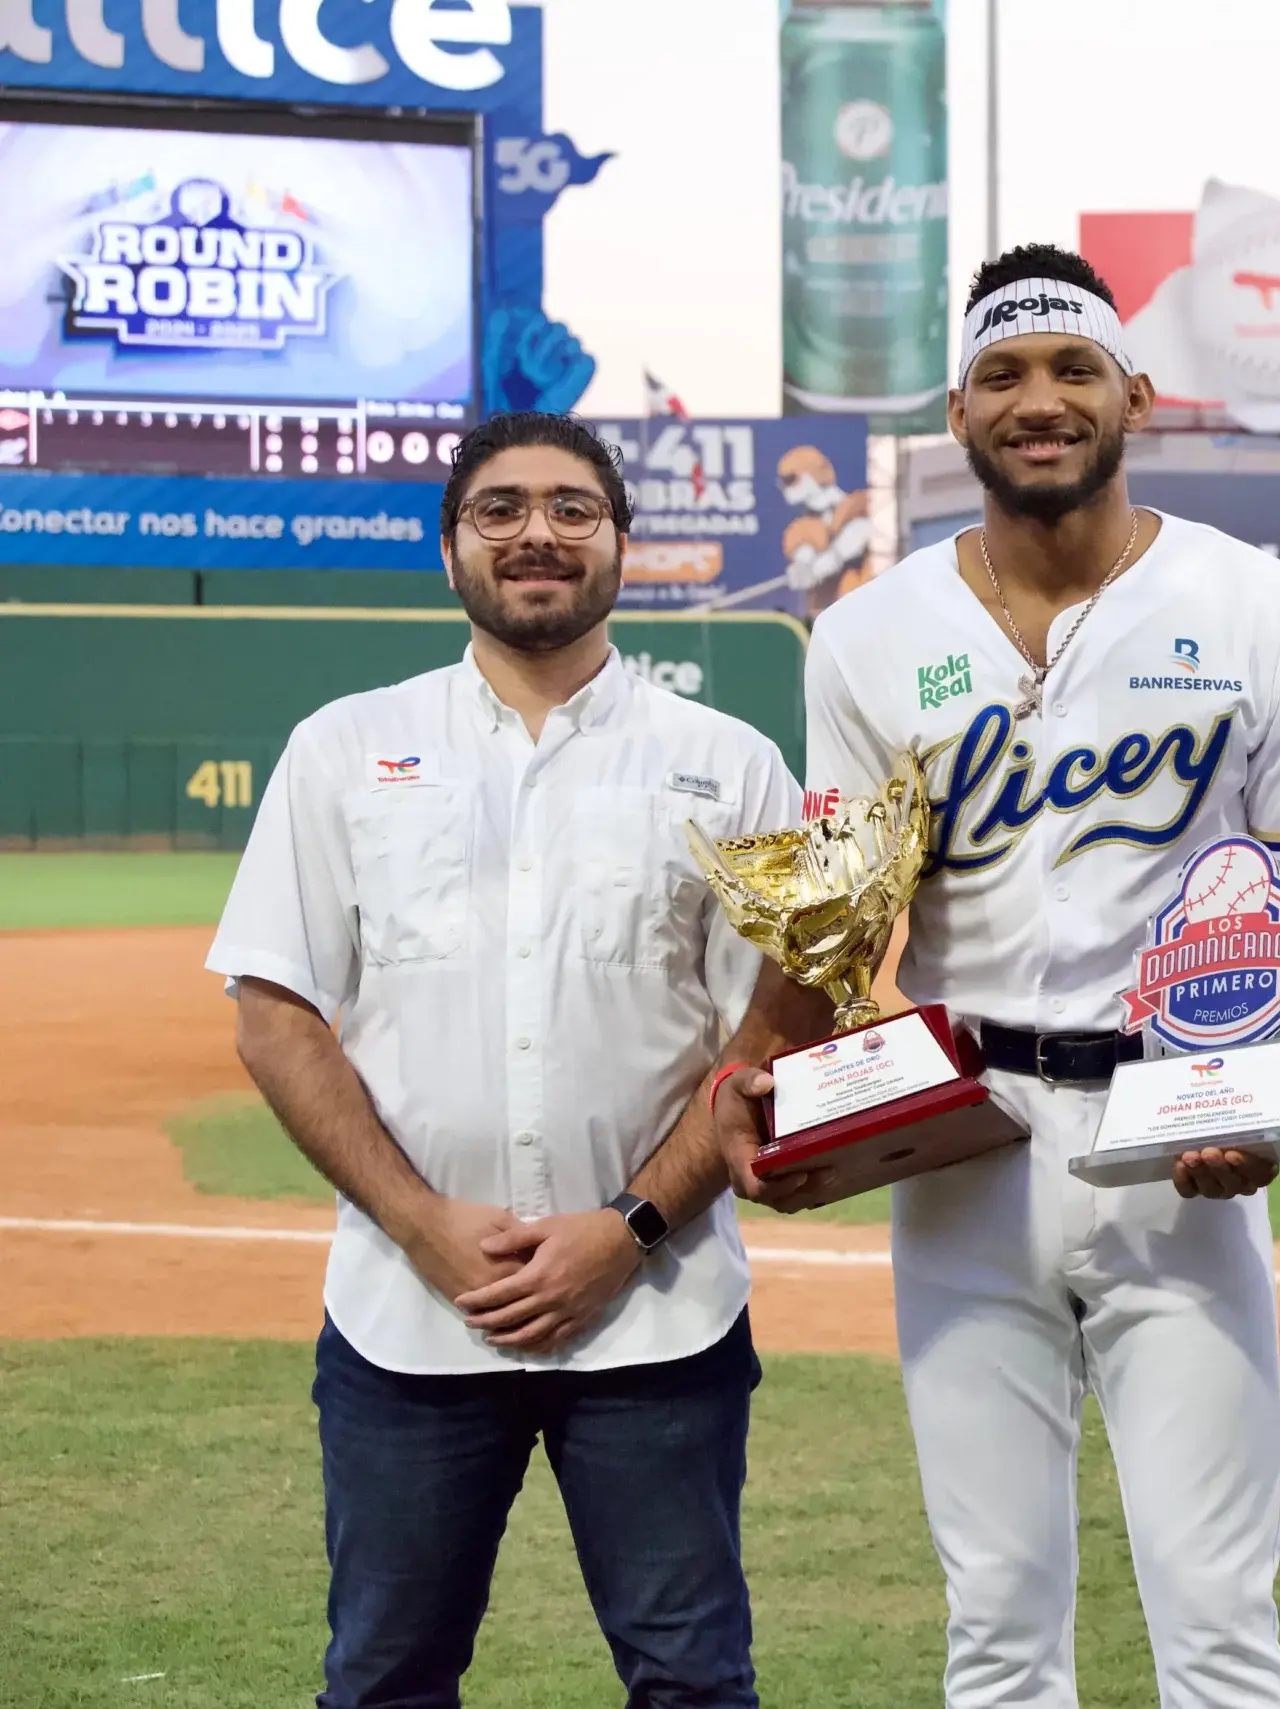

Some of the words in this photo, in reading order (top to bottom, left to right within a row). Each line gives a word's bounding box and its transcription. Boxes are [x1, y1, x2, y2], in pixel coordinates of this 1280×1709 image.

[495, 137, 570, 194] 5G
[101, 224, 302, 270] ROUND
[83, 264, 322, 320] ROBIN
[975, 293, 1083, 340] JRojas
[367, 431, 394, 462] 0
[402, 432, 429, 464] 0
[0, 507, 129, 535] onectar
[139, 512, 197, 537] nos
[205, 509, 284, 538] hace
[291, 511, 423, 545] grandes
[917, 653, 971, 689] Kola
[1129, 676, 1243, 692] BANRESERVAS
[920, 670, 972, 710] Real
[186, 760, 252, 807] 411
[928, 702, 1233, 879] Licey
[1208, 916, 1243, 934] LOS
[1176, 972, 1273, 1002] PRIMERO
[1193, 1002, 1249, 1023] PREMIOS
[816, 1075, 846, 1091] JOHAN
[847, 1066, 874, 1081] ROJAS
[876, 1059, 894, 1072] (GC)
[824, 1062, 855, 1078] GUANTES
[866, 1054, 880, 1063] ORO
[1157, 1102, 1192, 1115] JOHAN
[1194, 1097, 1228, 1110] ROJAS
[1231, 1094, 1254, 1106] (GC)
[1176, 1091, 1204, 1100] NOVATO
[1219, 1086, 1235, 1095] AÑO
